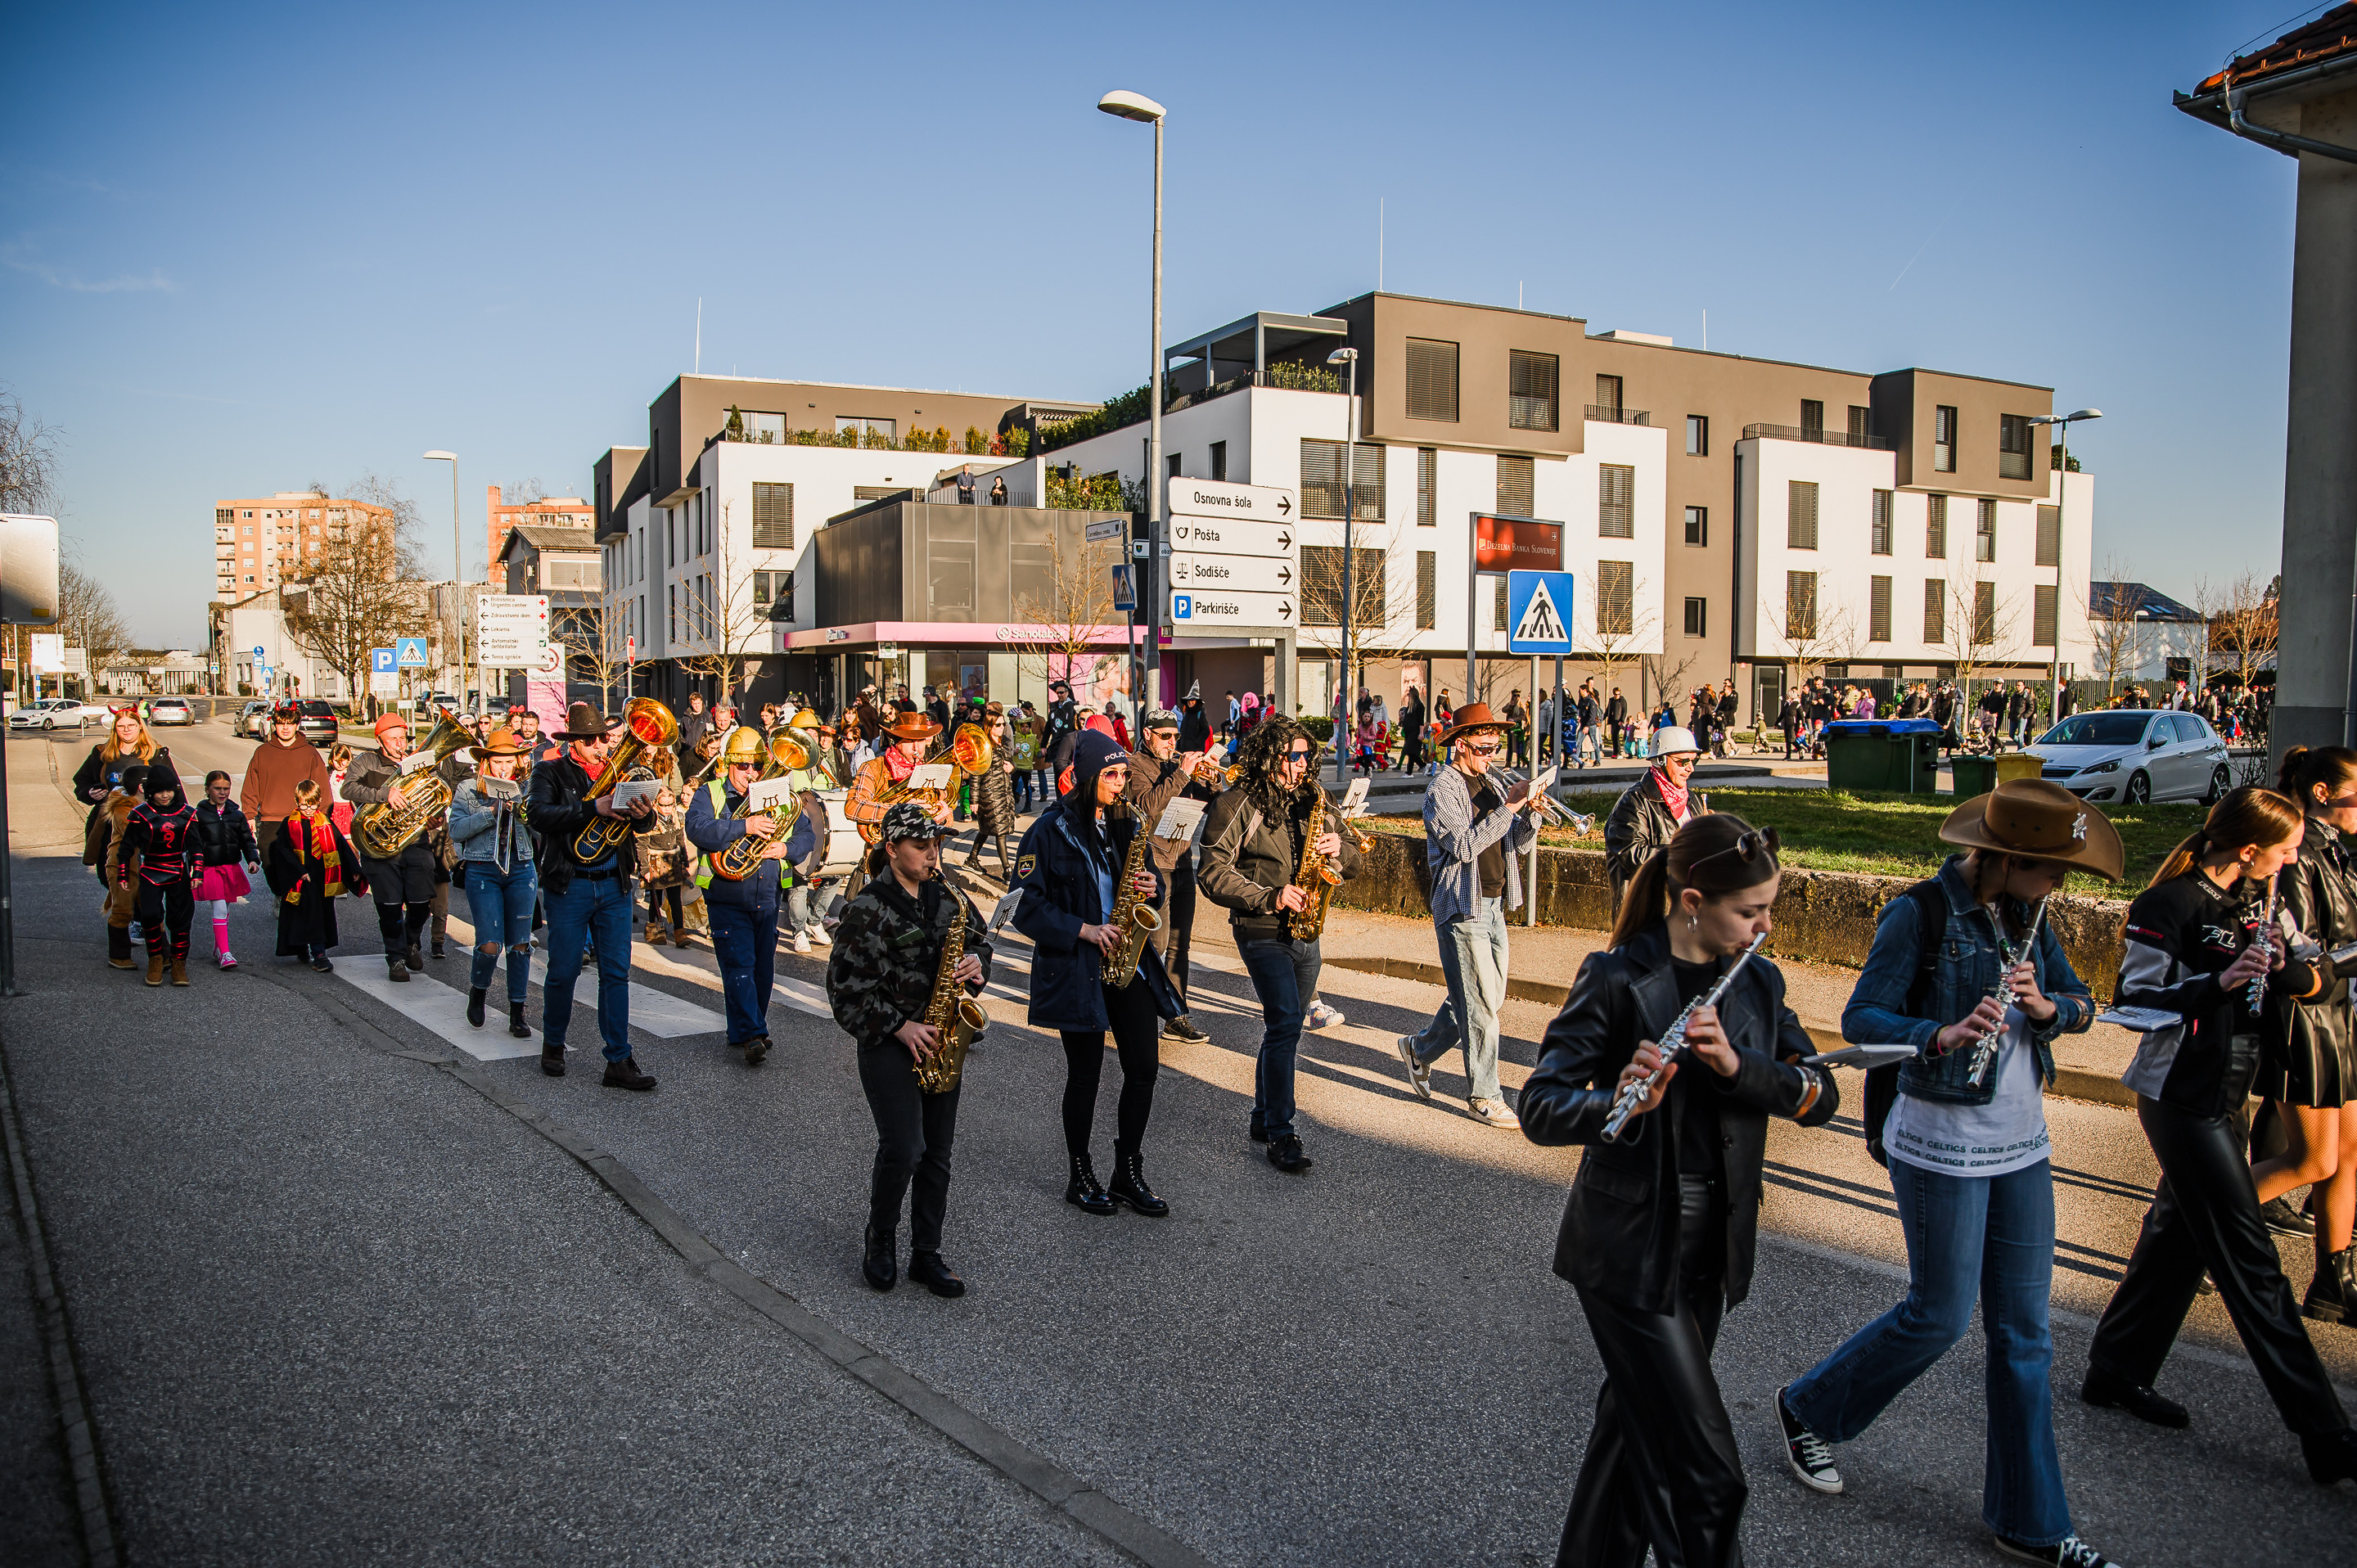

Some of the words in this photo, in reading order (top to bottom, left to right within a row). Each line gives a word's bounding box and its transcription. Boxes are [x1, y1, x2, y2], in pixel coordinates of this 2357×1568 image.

[1194, 492, 1232, 506] Osnovna
[1234, 496, 1252, 508] šola
[1194, 528, 1220, 542] Pošta
[1487, 540, 1511, 552] DEŽELNA
[1512, 543, 1530, 553] BANKA
[1530, 544, 1557, 556] SLOVENIJE
[1195, 565, 1229, 578] Sodišče
[1178, 599, 1188, 615] P
[1195, 602, 1239, 615] Parkirišče
[378, 651, 393, 669] P
[1104, 751, 1125, 762] POLIC
[1897, 1129, 1923, 1144] ELTICS
[1927, 1140, 1966, 1153] CELTICS
[1971, 1147, 2004, 1155] CELTICS
[2007, 1139, 2034, 1151] CELTICS
[1895, 1141, 1921, 1156] ELTICS
[1925, 1153, 1965, 1166] CELTICS
[1970, 1158, 2002, 1167] CELTICS
